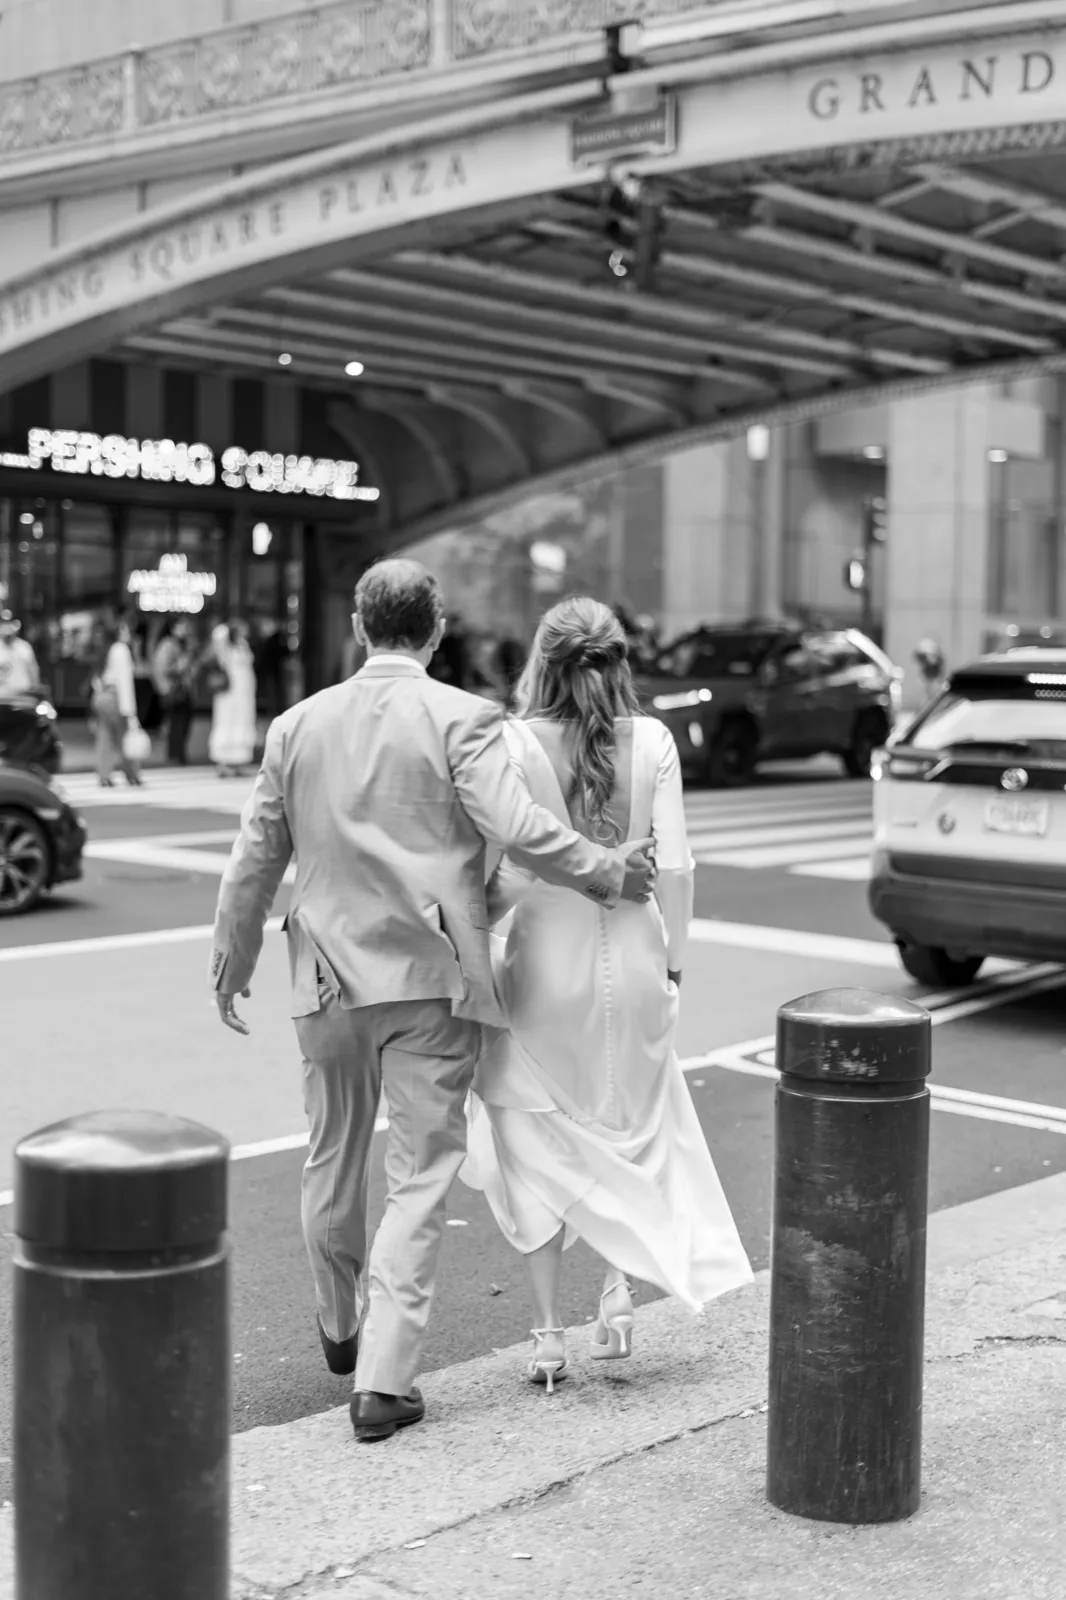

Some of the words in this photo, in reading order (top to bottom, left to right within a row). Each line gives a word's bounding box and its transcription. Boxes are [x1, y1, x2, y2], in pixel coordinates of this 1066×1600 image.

[808, 51, 1056, 121] GRAND
[0, 265, 104, 338] HING
[128, 202, 288, 282] SQUARE
[318, 152, 467, 222] PLAZA
[27, 427, 216, 486] PERSHING
